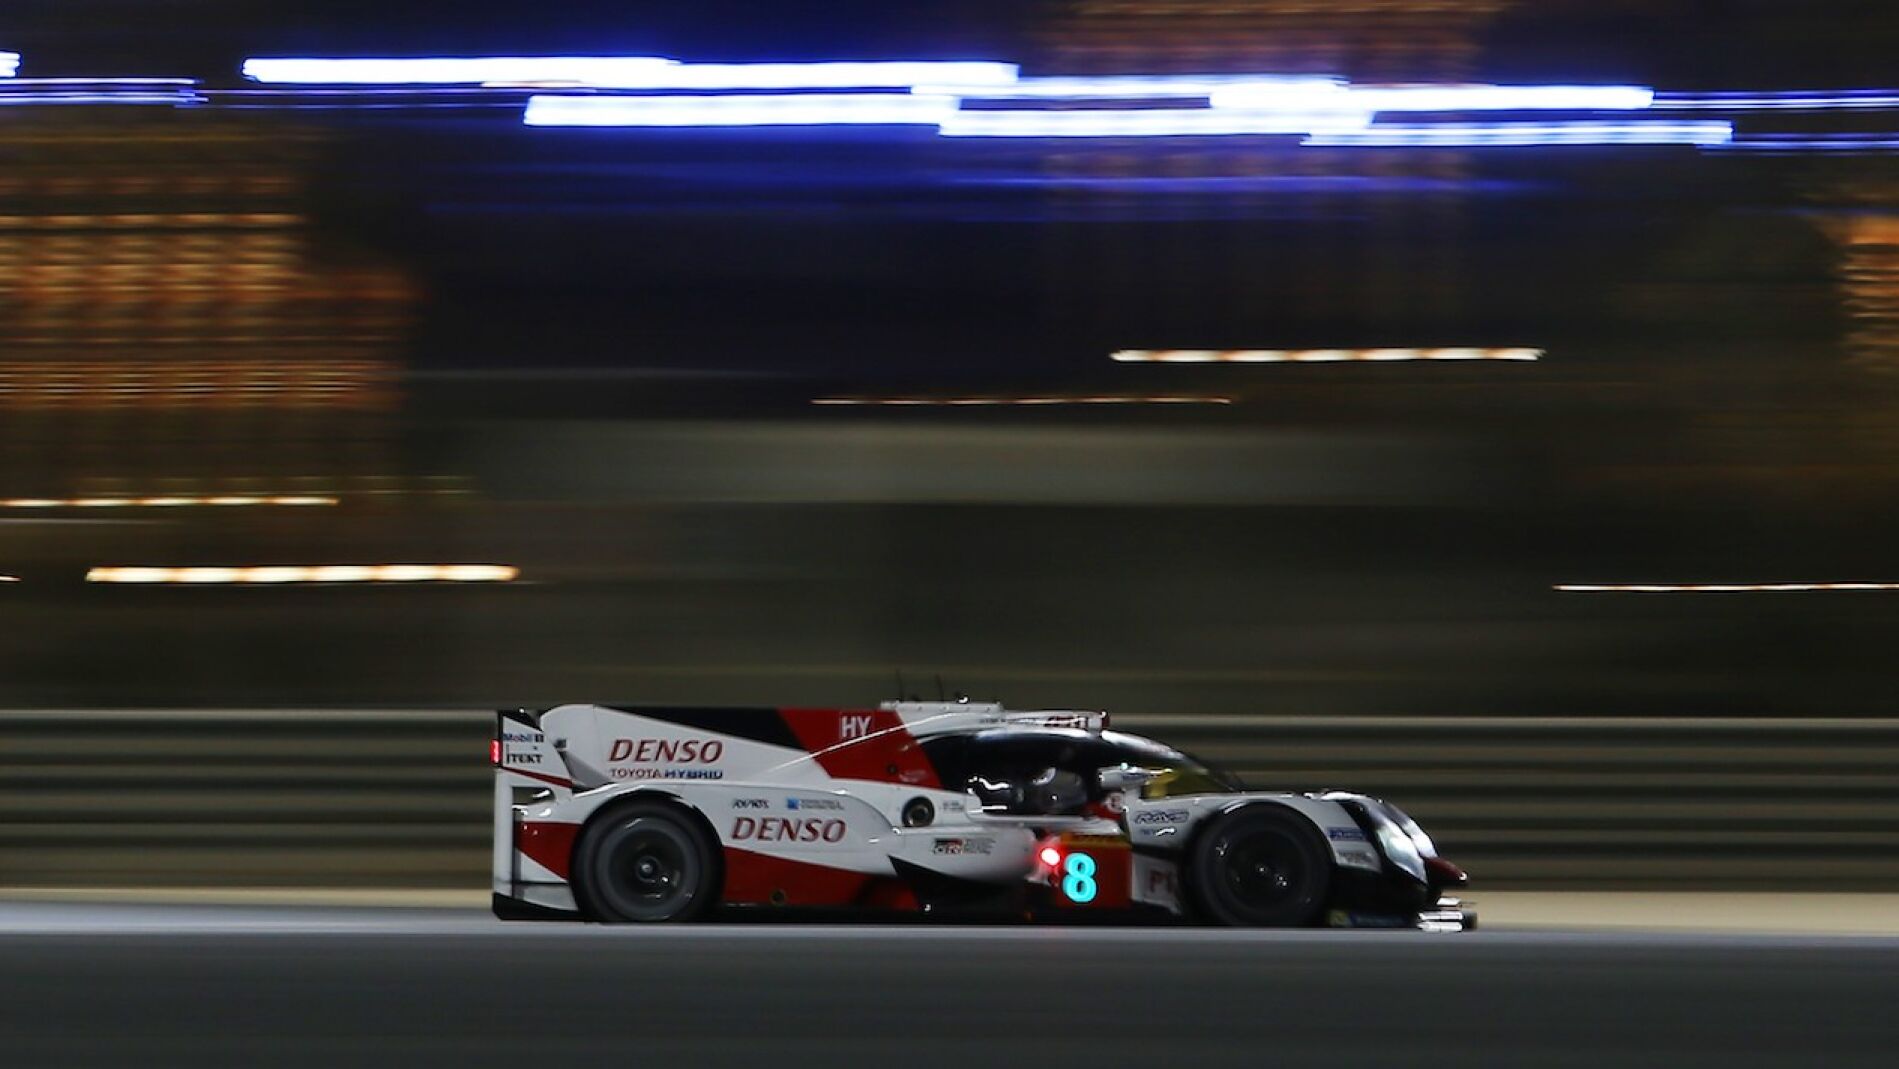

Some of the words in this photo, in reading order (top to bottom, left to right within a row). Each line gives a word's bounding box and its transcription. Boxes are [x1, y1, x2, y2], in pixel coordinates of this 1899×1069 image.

[840, 715, 872, 738] HY
[608, 739, 723, 763] DENSO
[610, 768, 662, 779] TOYOTA
[731, 816, 847, 843] DENSO
[1062, 852, 1098, 904] 8
